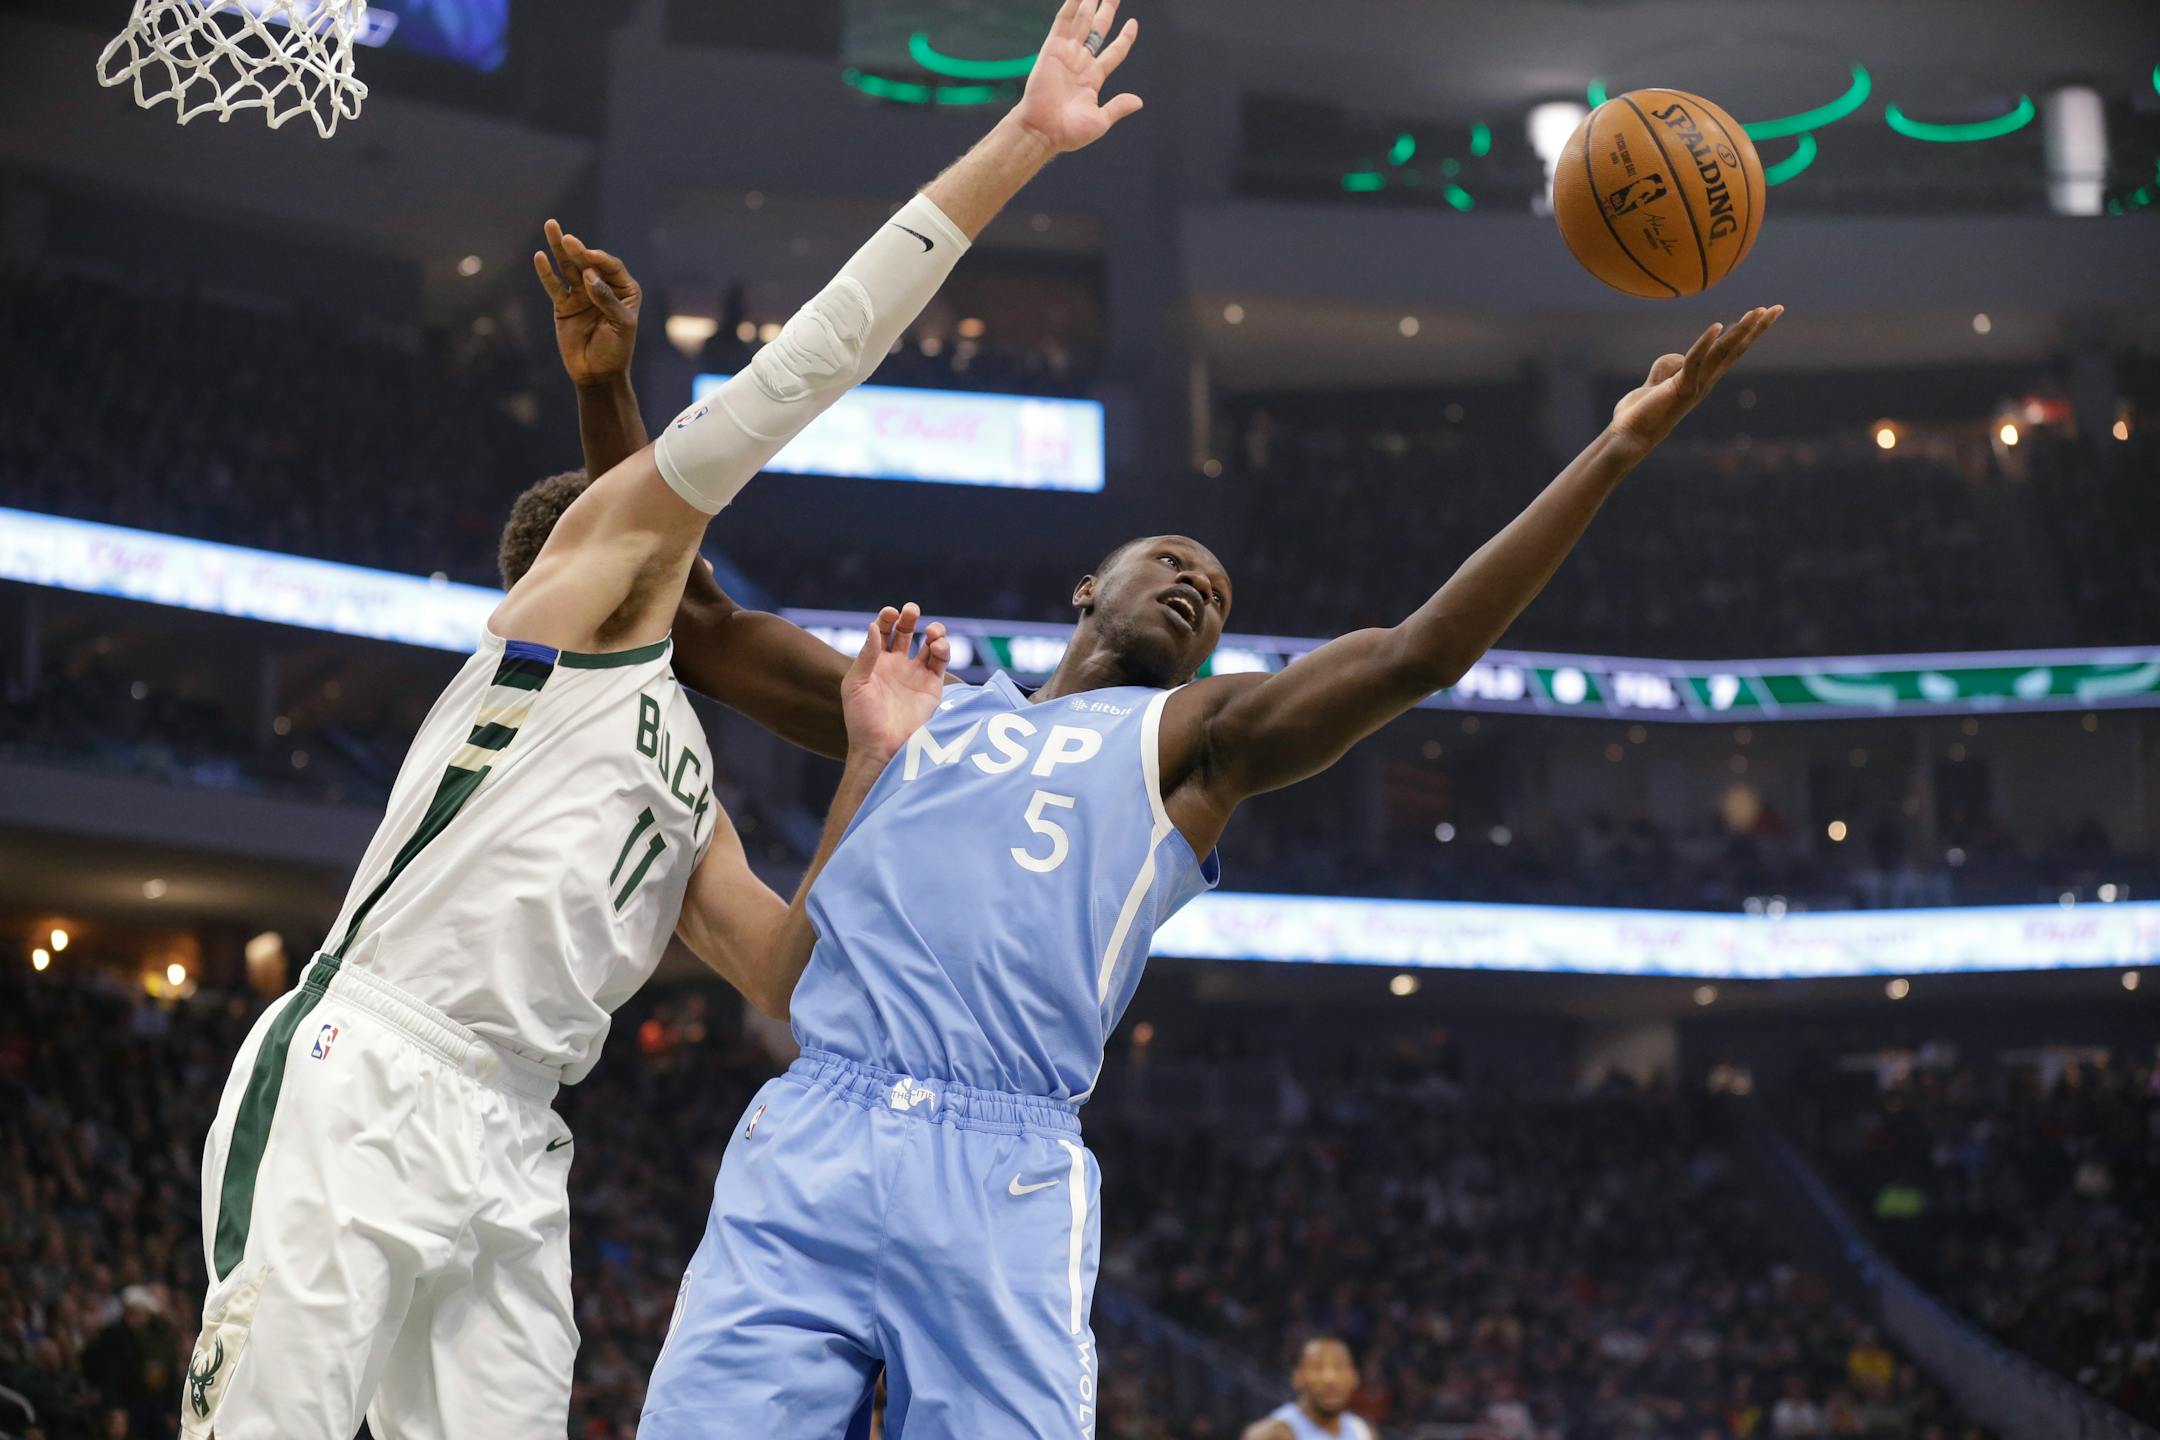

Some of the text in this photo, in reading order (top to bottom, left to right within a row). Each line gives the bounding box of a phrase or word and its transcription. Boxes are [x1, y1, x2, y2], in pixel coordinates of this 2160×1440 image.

[1651, 103, 1738, 241] SPALDING
[902, 712, 1103, 781] MSP
[1090, 702, 1132, 716] fitbit
[609, 806, 667, 913] 11
[1009, 789, 1076, 873] 5
[892, 1090, 910, 1101] THE
